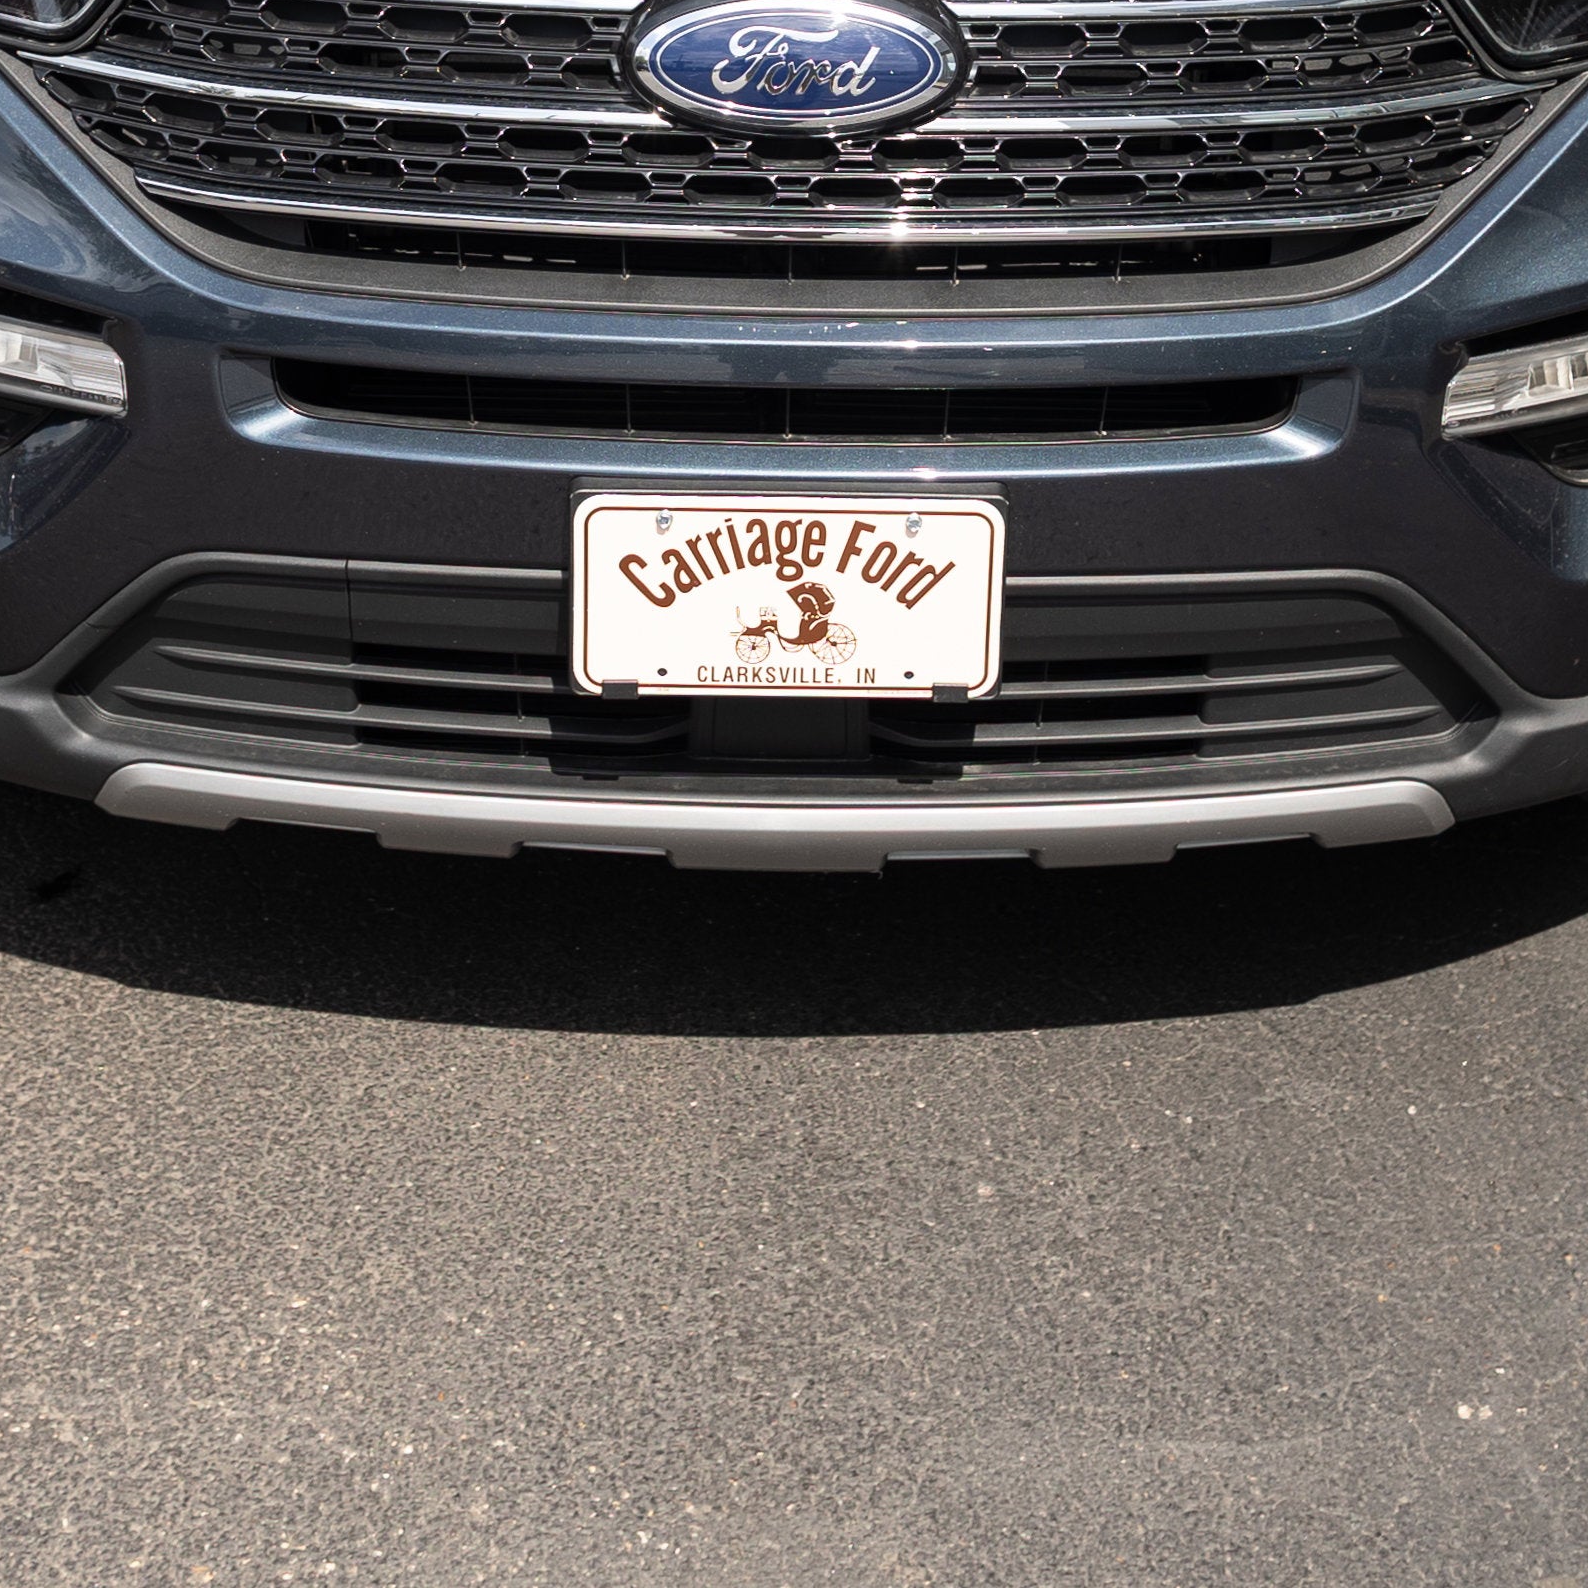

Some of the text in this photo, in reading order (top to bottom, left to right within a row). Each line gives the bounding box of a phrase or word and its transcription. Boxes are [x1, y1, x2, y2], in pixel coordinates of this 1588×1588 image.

[711, 25, 881, 96] Ford
[618, 518, 956, 610] Carriage Ford
[856, 667, 876, 684] IN
